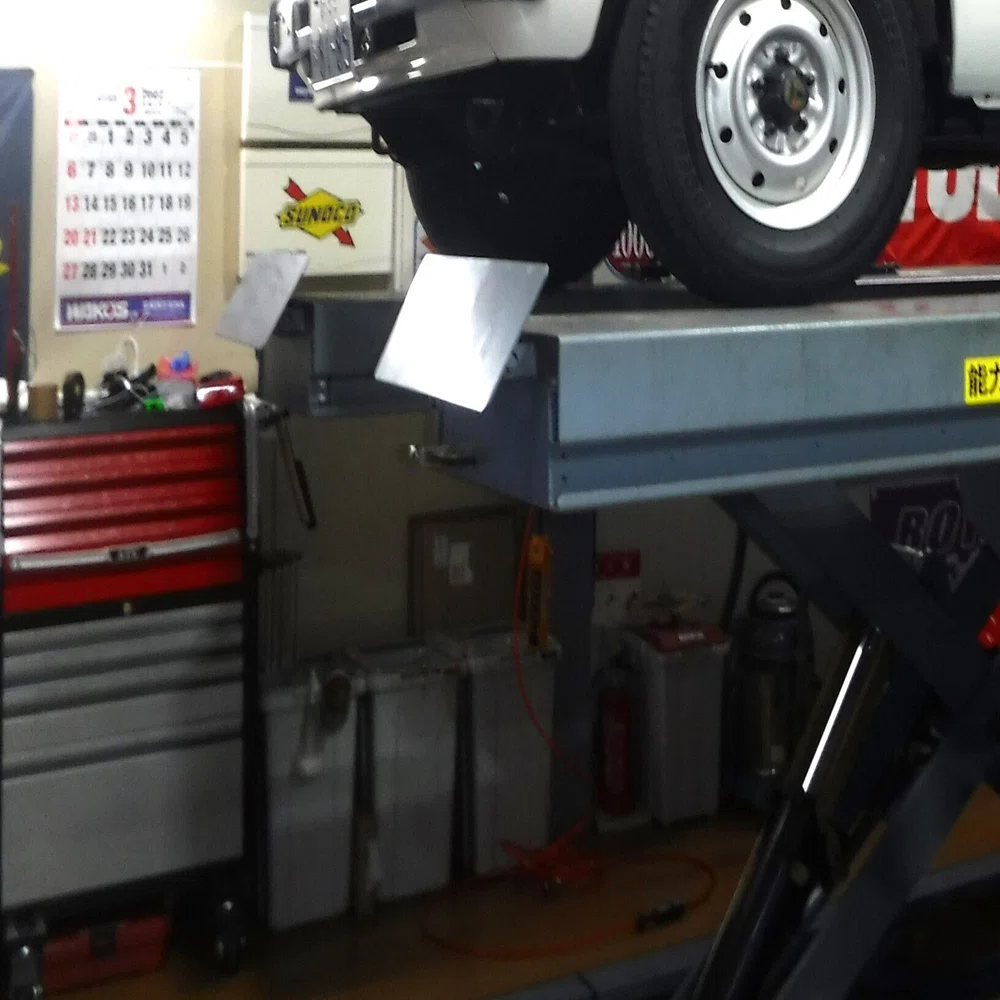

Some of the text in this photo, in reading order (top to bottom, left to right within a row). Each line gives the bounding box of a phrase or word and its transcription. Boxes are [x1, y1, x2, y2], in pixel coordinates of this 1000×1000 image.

[123, 86, 136, 115] 3
[87, 160, 95, 178] 7
[142, 160, 155, 178] 10
[160, 160, 172, 178] 11
[66, 194, 79, 212] 13
[84, 194, 98, 212] 14
[104, 194, 117, 212] 15
[122, 194, 136, 212] 16
[141, 194, 154, 212] 17
[160, 194, 173, 212] 18
[83, 227, 96, 245] 21
[102, 227, 116, 245] 22
[121, 227, 135, 245] 23
[140, 227, 154, 245] 24
[63, 261, 78, 280] 27
[82, 261, 97, 280] 28
[102, 261, 116, 280] 29
[120, 261, 135, 280] 30
[140, 261, 152, 280] 31
